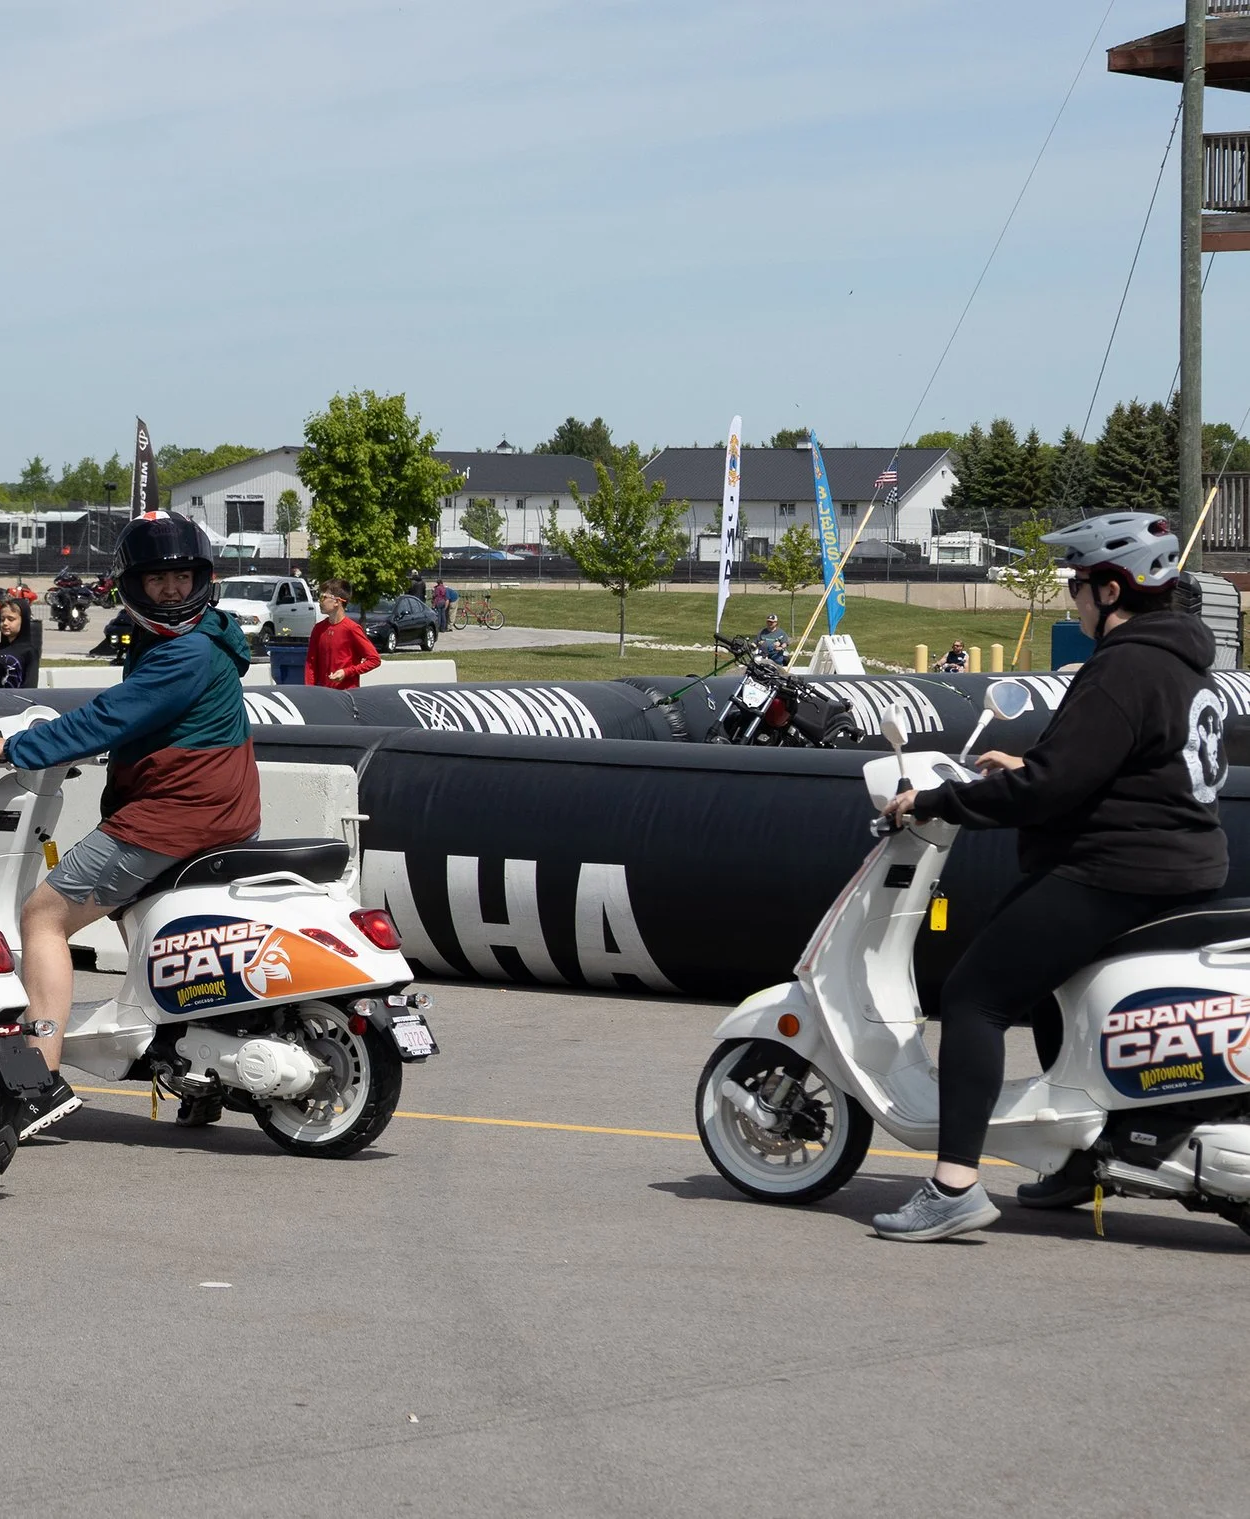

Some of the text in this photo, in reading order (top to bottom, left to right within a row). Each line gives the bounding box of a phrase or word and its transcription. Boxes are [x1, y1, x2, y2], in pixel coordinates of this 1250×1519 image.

[433, 687, 602, 739] YAMAHA
[149, 922, 271, 957] ORANGE
[153, 939, 261, 988] CAT
[177, 979, 227, 1007] MOTOWORKS
[1102, 995, 1250, 1034] ORANGE
[1107, 1016, 1247, 1069] CAT
[1139, 1062, 1205, 1091] MOTOWORKS
